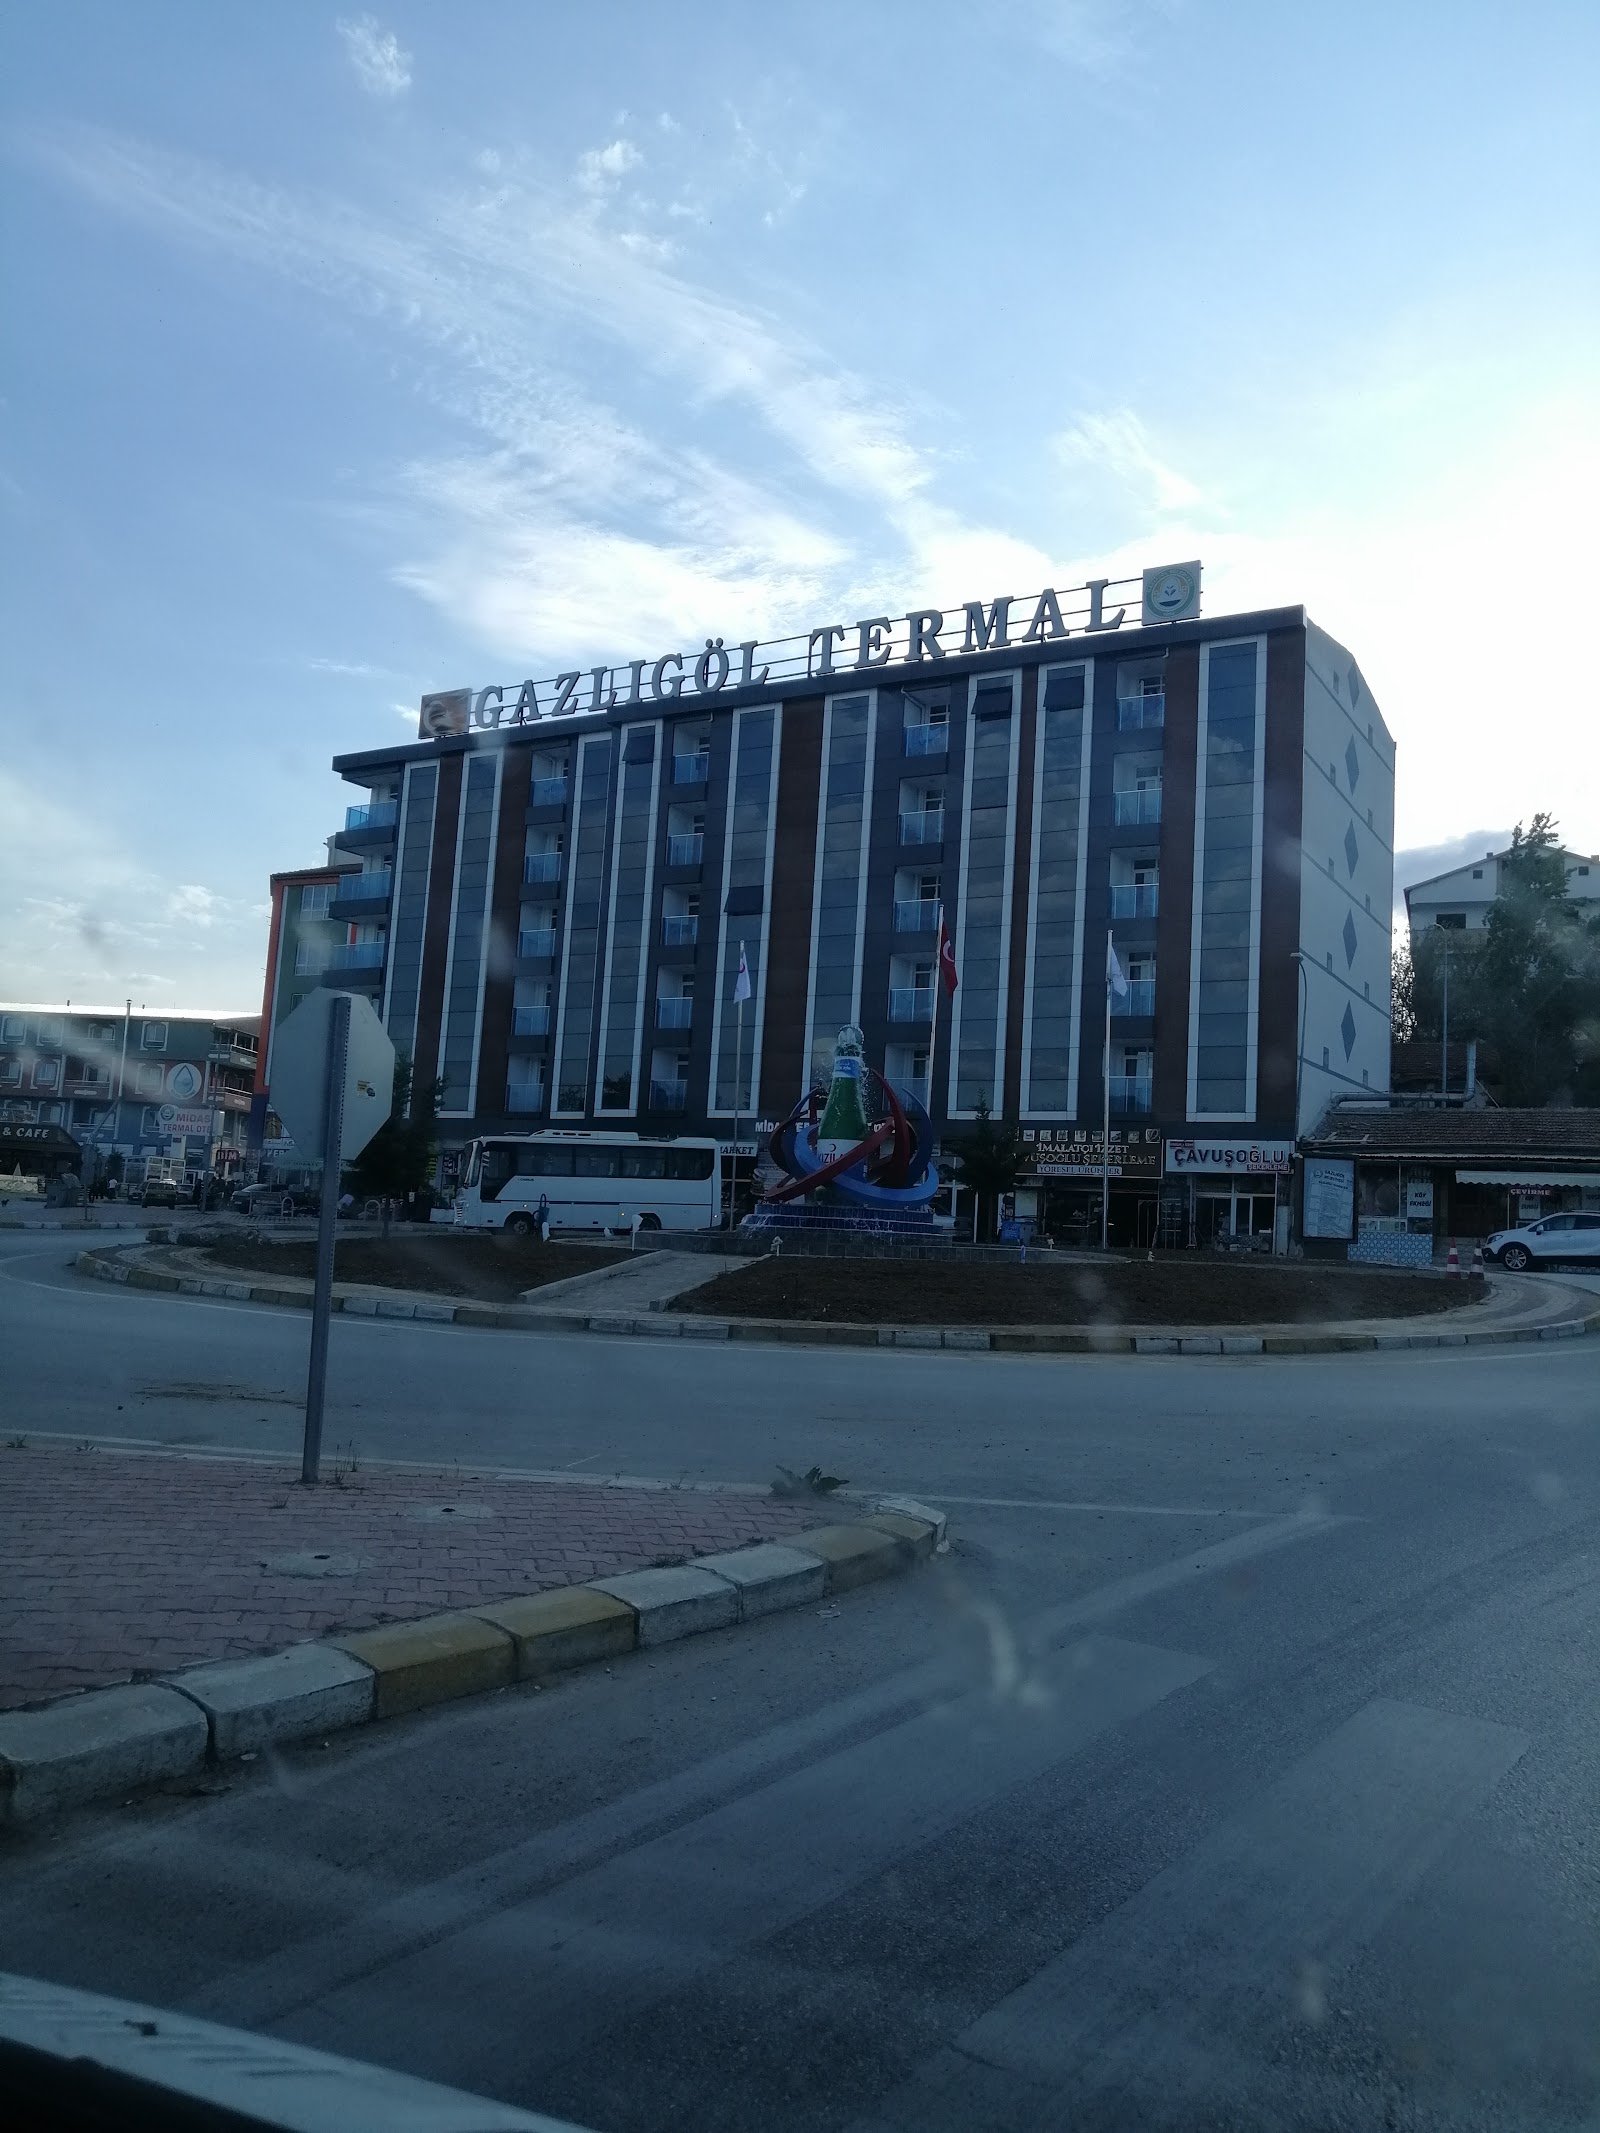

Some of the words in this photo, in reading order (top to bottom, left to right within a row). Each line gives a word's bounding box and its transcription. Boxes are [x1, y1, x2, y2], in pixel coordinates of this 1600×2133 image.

[475, 638, 770, 729] GAZLIGÖL
[811, 579, 1126, 675] TERMAL
[163, 1123, 194, 1133] TERMAL
[196, 1125, 211, 1133] OTE
[755, 1119, 780, 1133] MİDA
[16, 1127, 50, 1139] CAFE
[1174, 1146, 1284, 1168] ÇAVUŞOĞLU
[1078, 1166, 1120, 1175] ÜRÜNER
